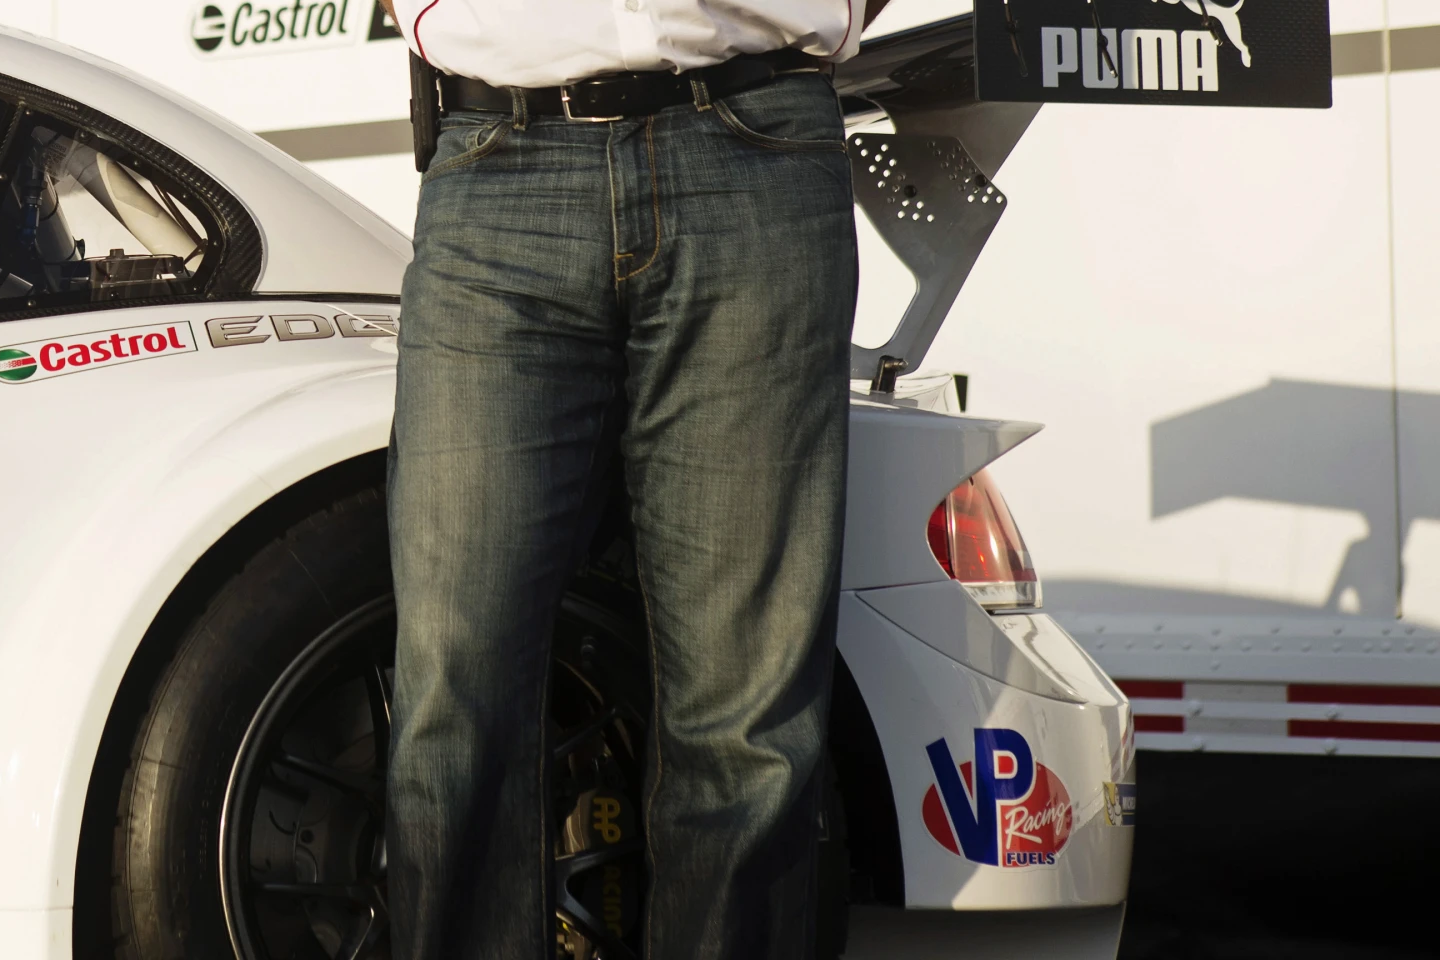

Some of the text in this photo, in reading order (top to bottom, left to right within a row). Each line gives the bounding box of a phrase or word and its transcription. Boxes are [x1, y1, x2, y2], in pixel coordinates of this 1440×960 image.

[1041, 26, 1219, 92] PUMA
[39, 313, 400, 373] Castrol EDG
[925, 728, 1034, 867] VP
[1005, 798, 1071, 849] Racing
[1007, 852, 1056, 866] FUELS
